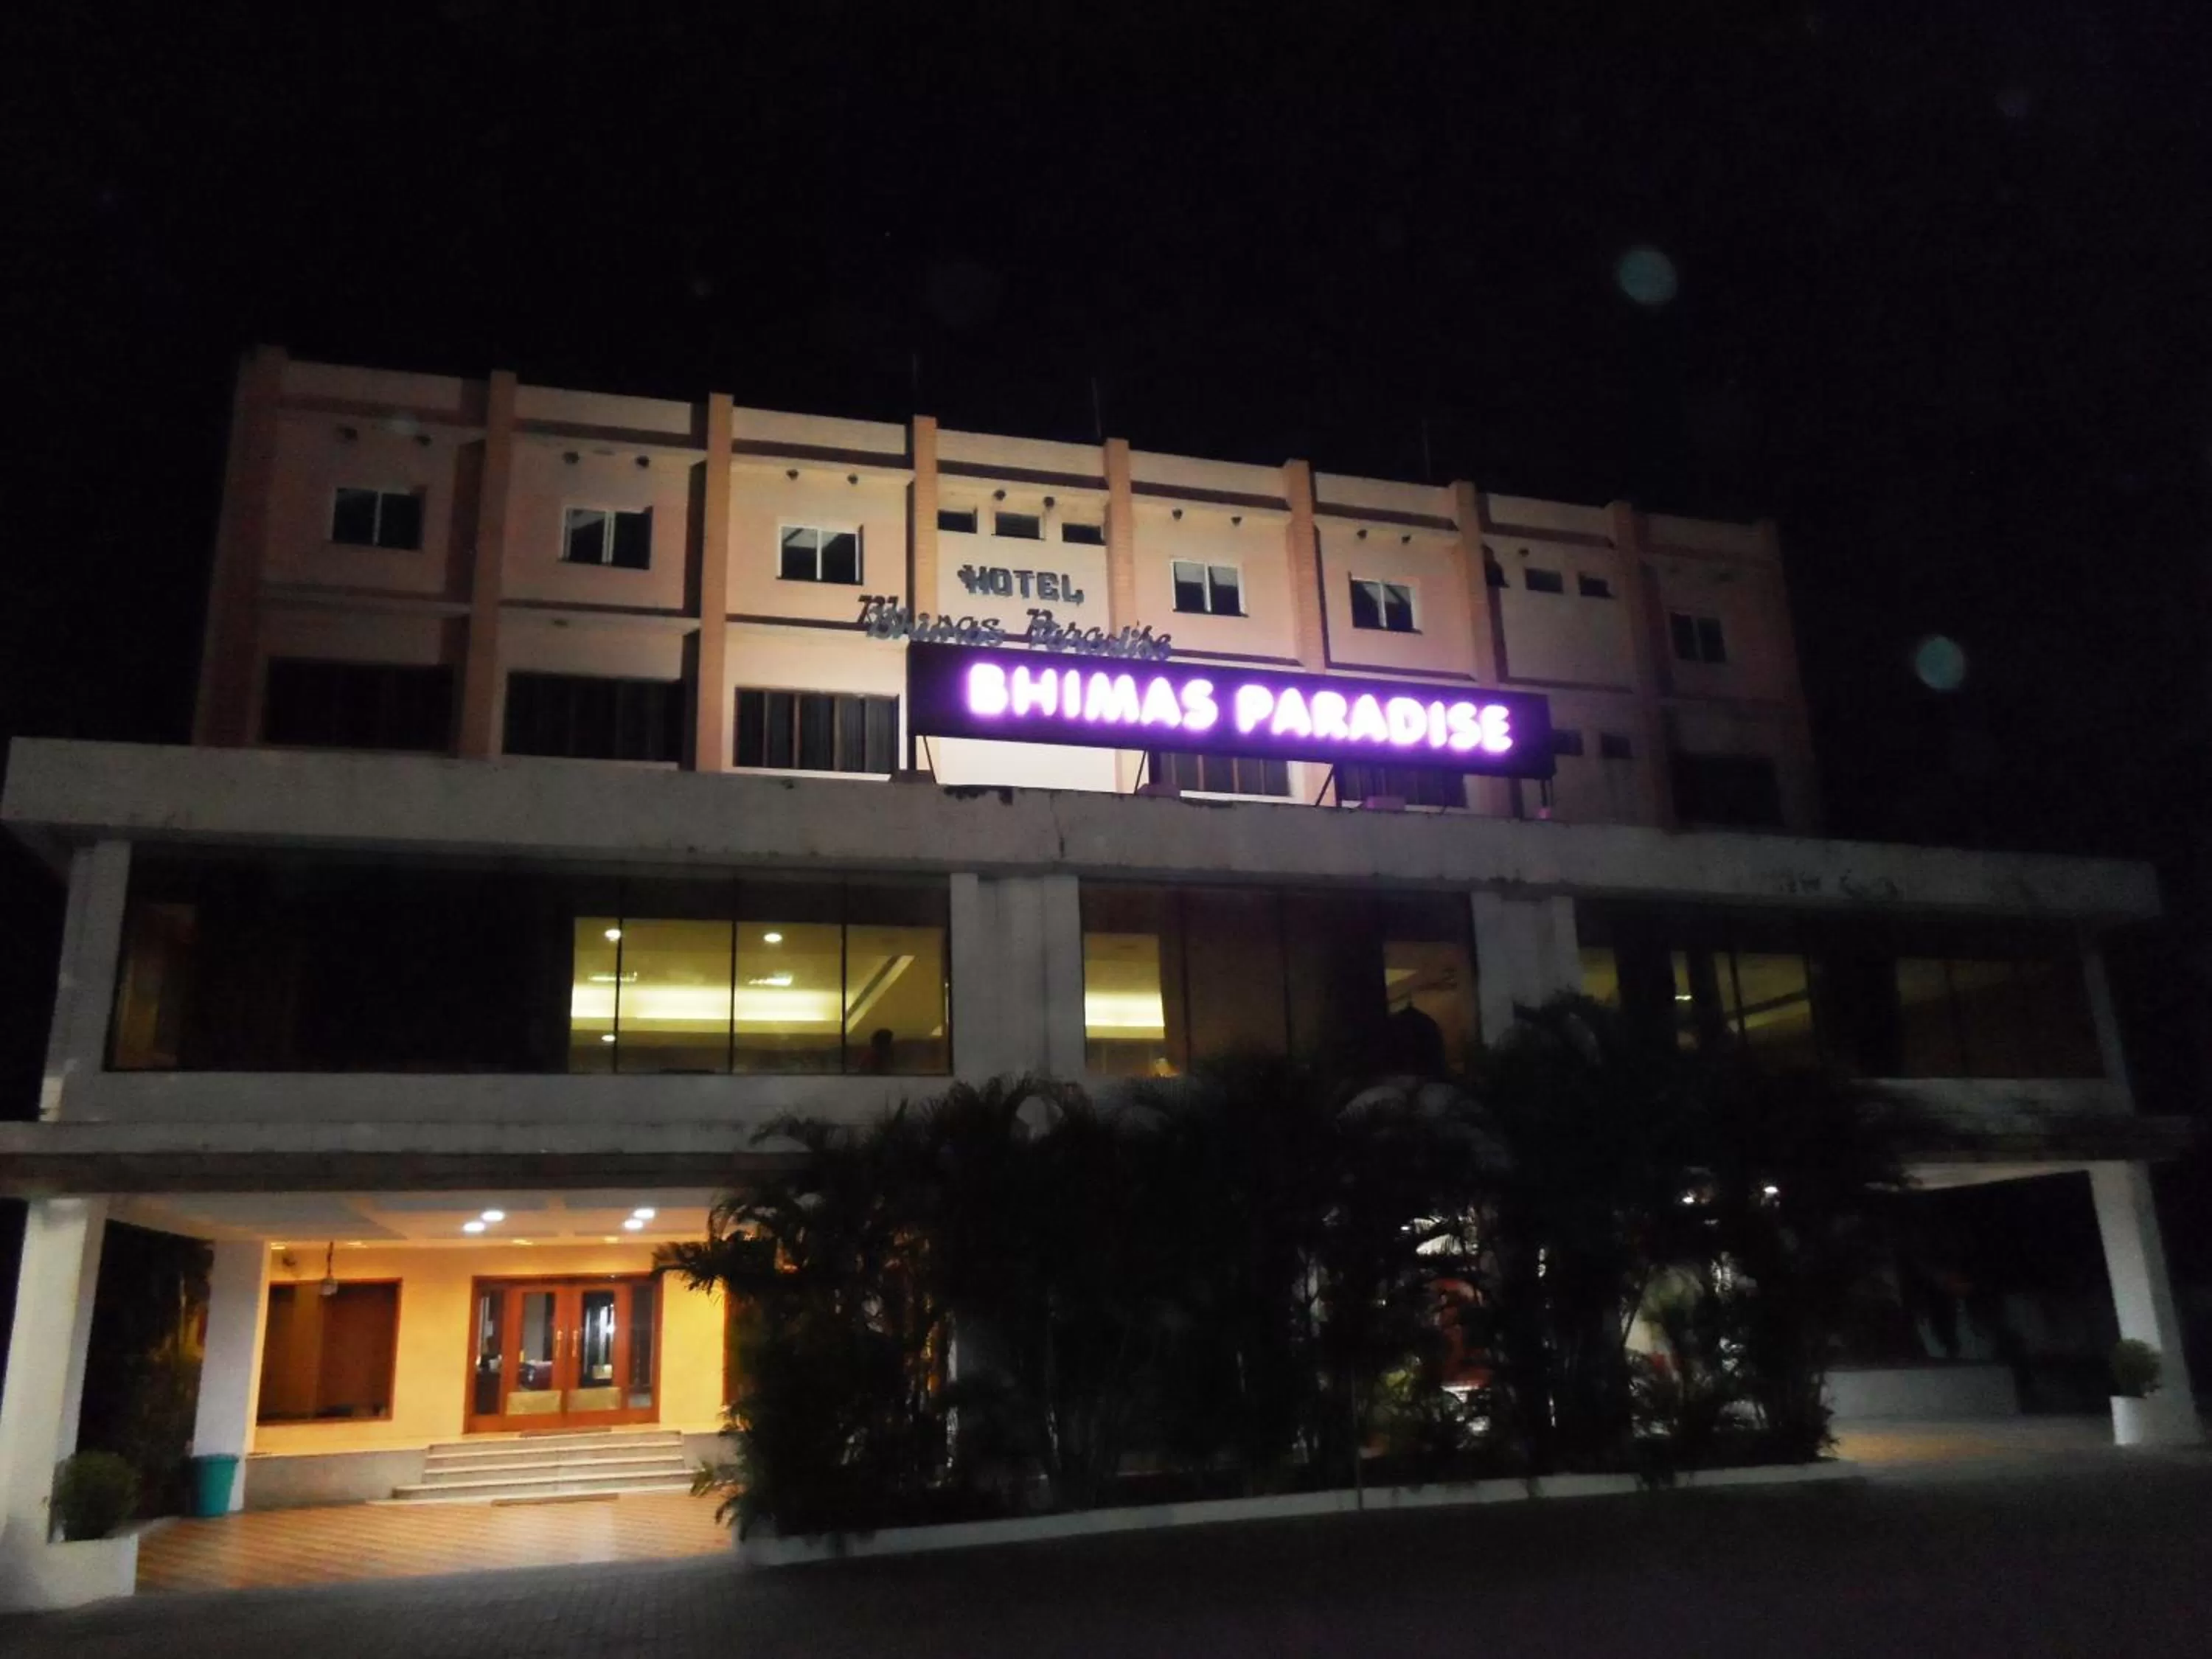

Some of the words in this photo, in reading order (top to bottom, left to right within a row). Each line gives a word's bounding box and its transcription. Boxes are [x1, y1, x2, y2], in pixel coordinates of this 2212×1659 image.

[959, 565, 1084, 605] HOTEL
[966, 661, 1220, 732] BHIMAS
[1234, 681, 1514, 754] PARADISE
